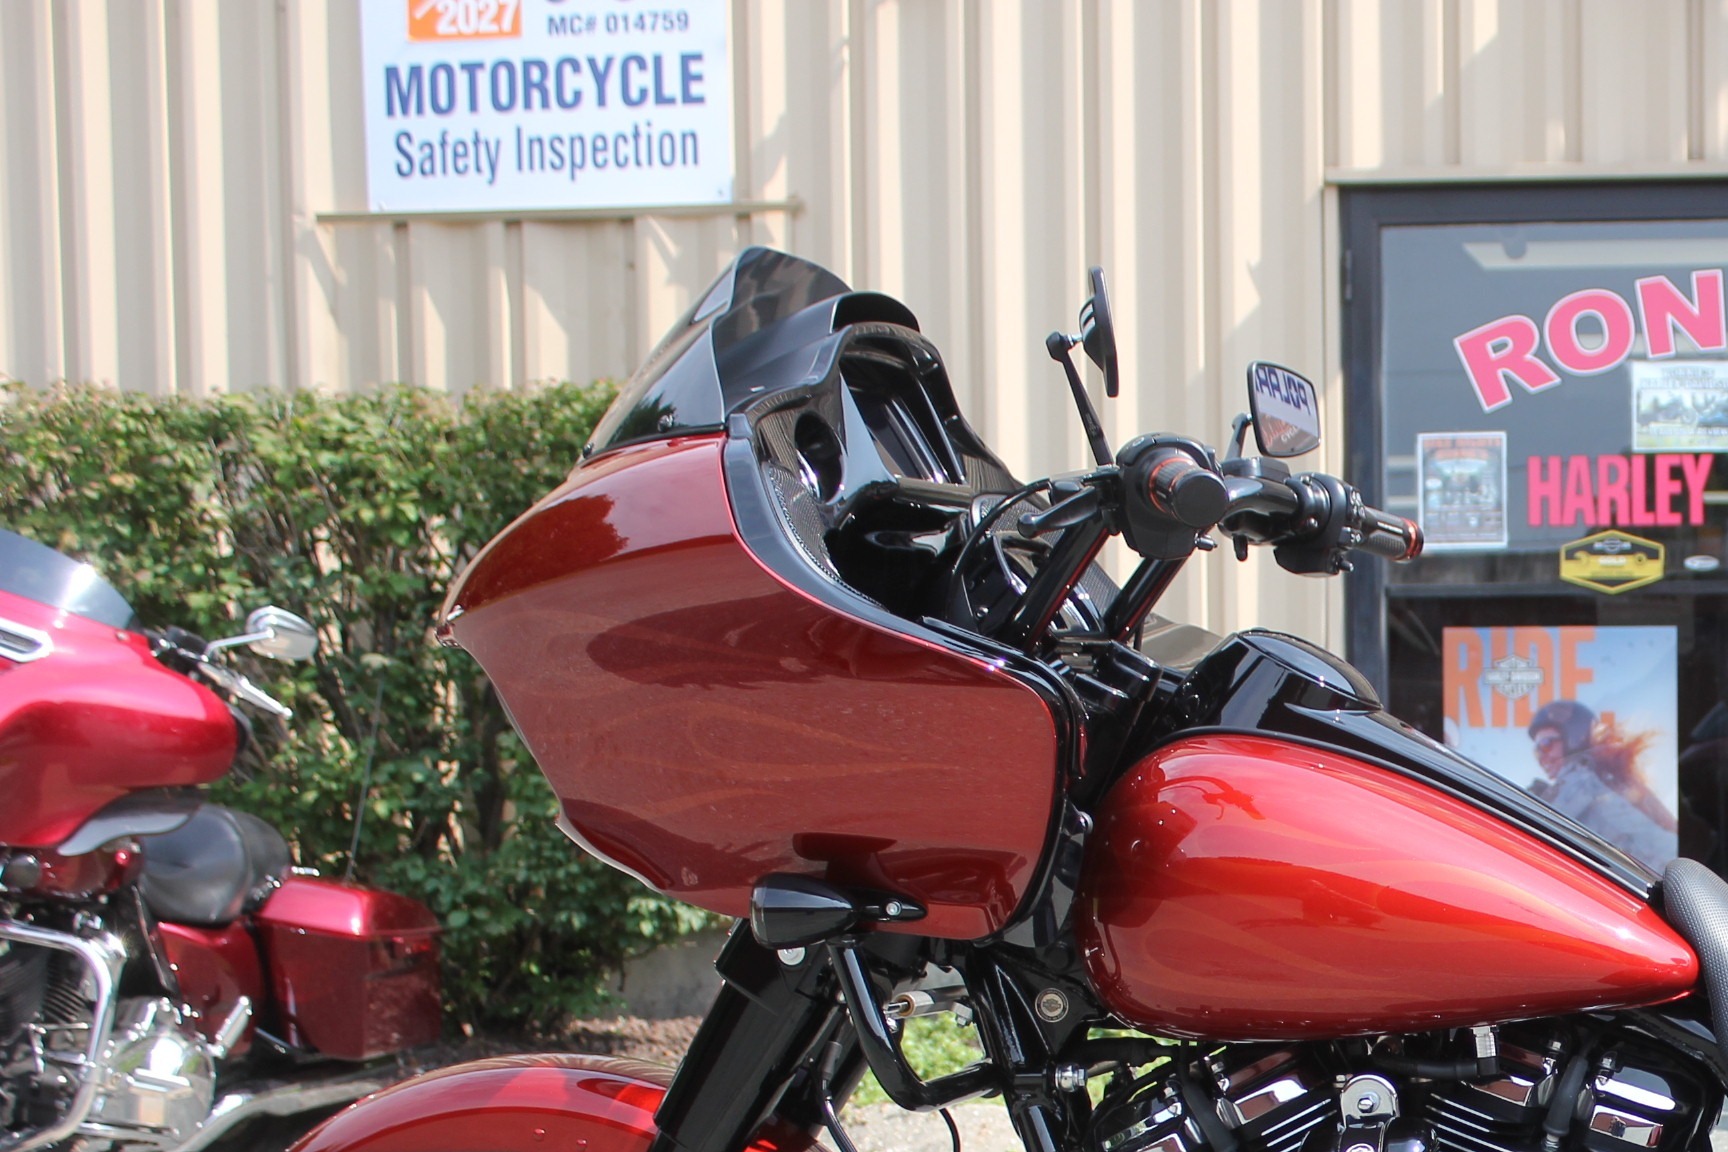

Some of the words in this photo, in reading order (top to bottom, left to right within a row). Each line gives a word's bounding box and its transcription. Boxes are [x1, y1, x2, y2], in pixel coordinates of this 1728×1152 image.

[547, 15, 597, 36] MC#
[604, 10, 690, 34] 014759
[384, 53, 706, 118] MOTORCYCLE
[395, 129, 501, 185] Safety
[516, 120, 700, 183] Inspection
[1453, 269, 1727, 413] RON
[1527, 453, 1714, 527] HARLEY
